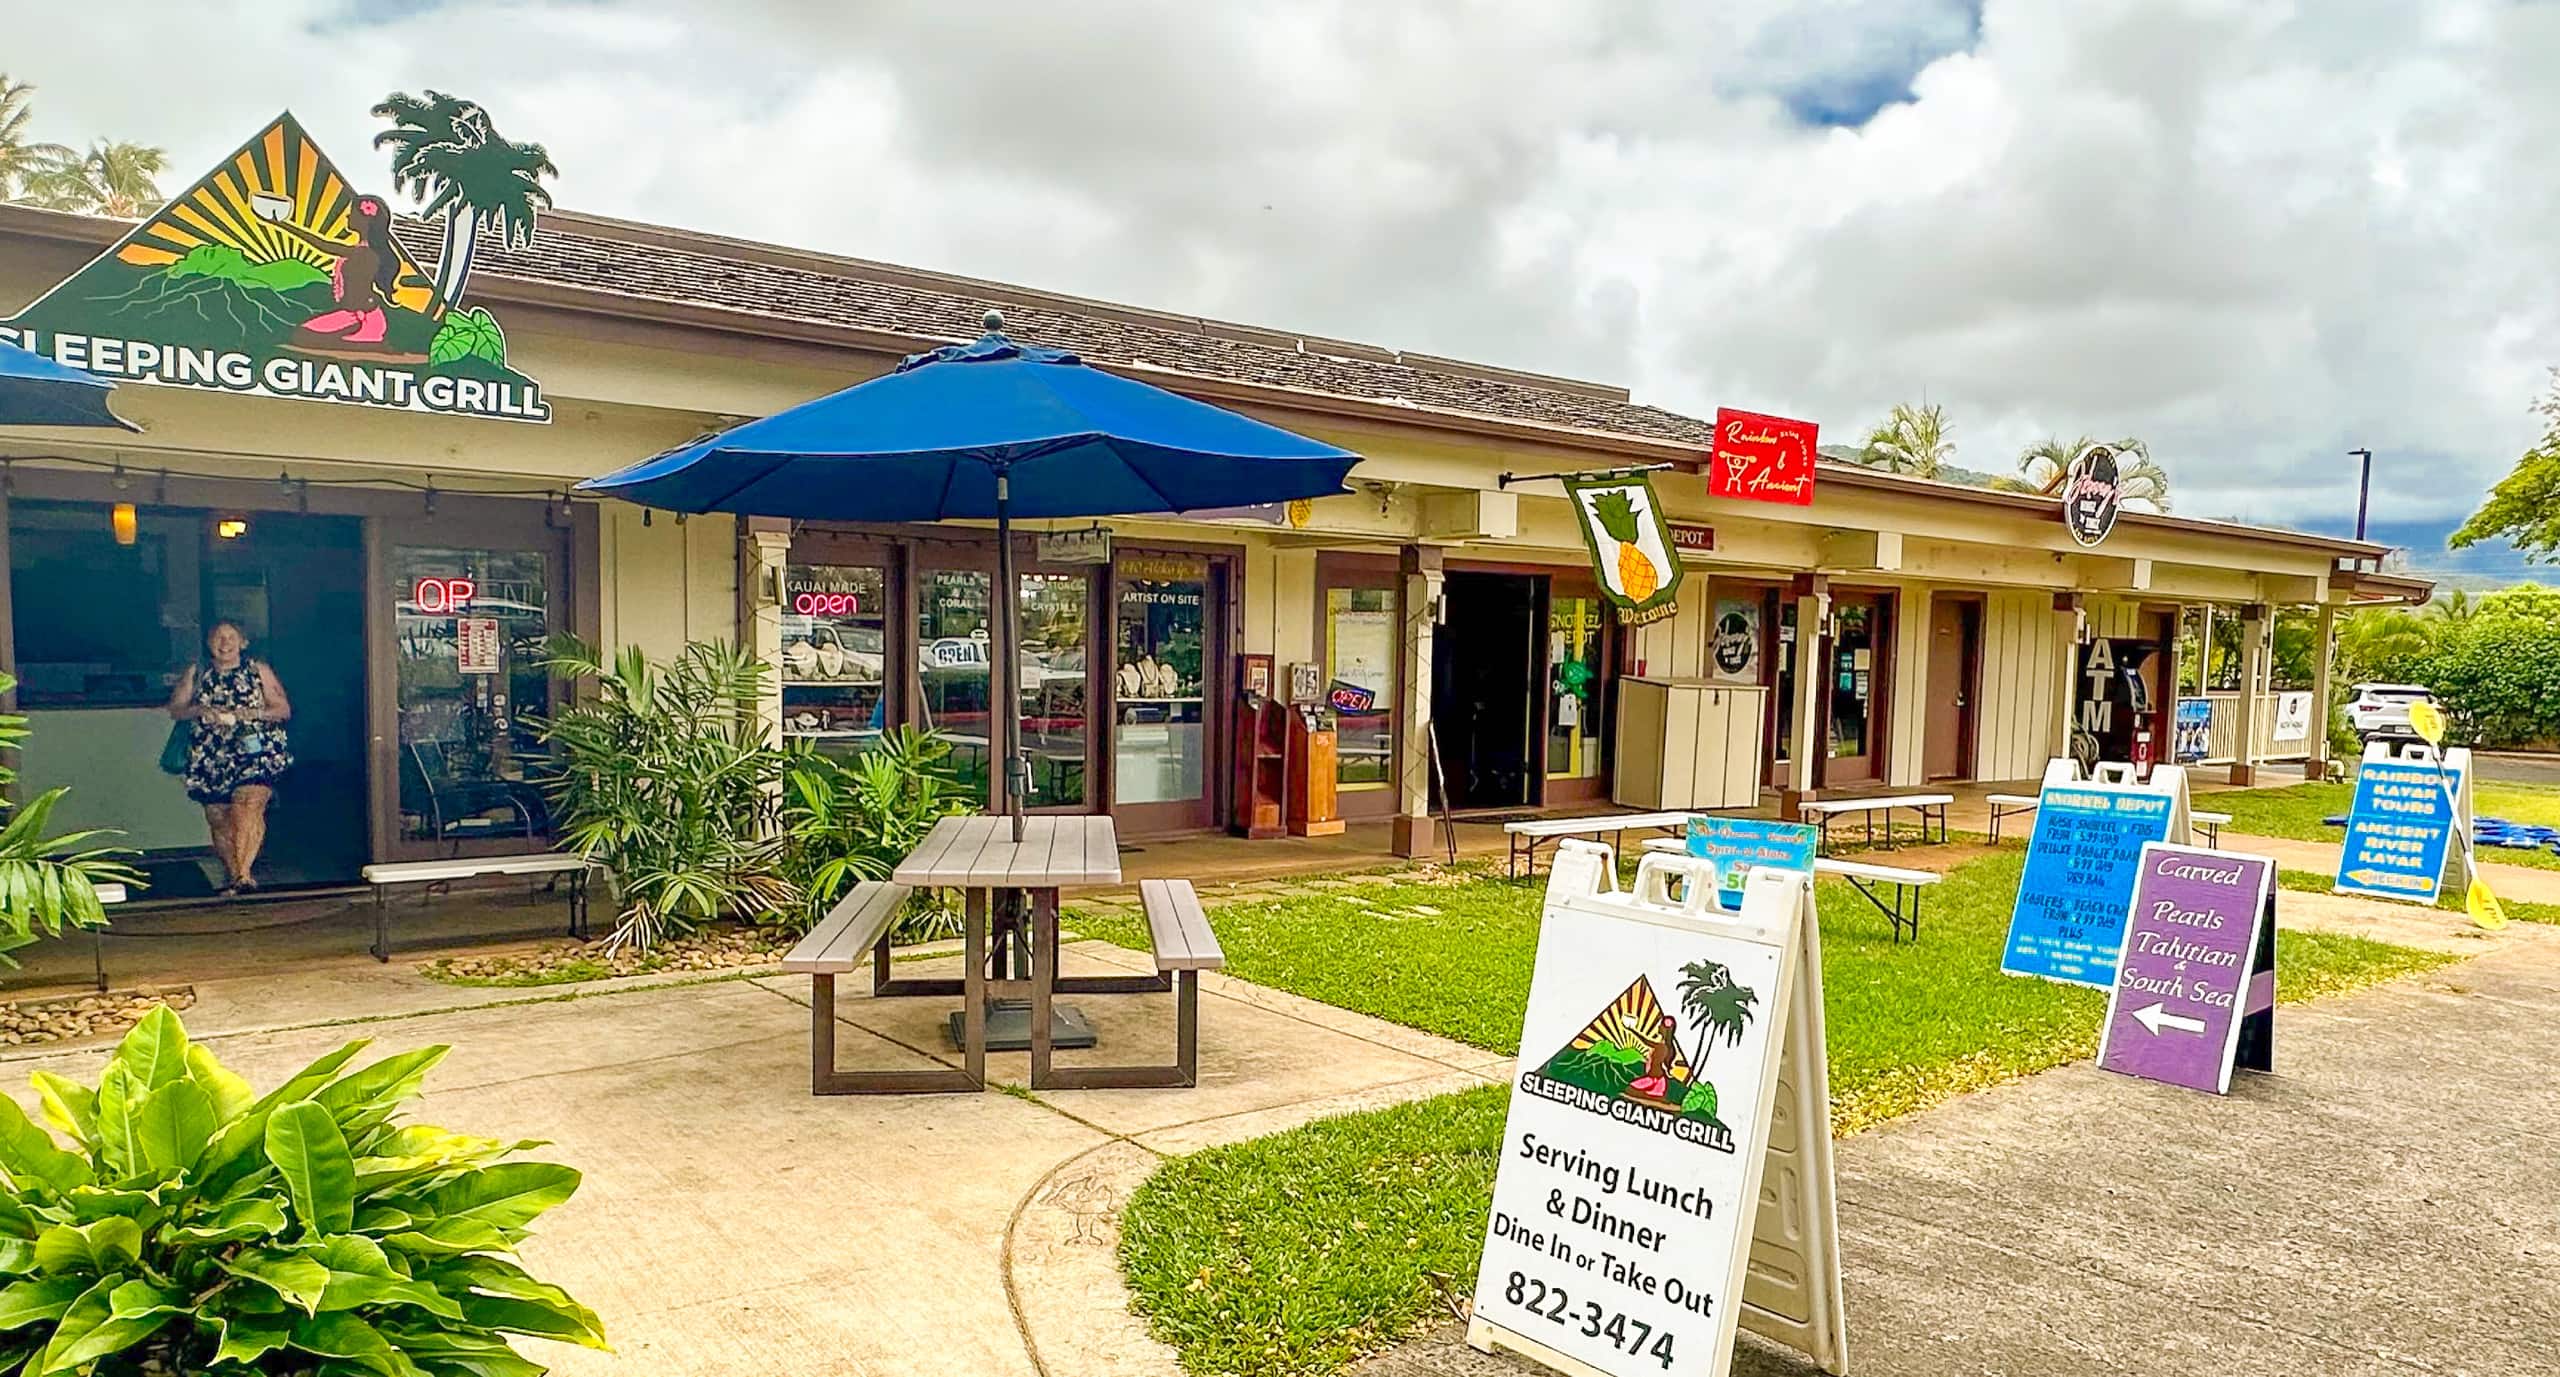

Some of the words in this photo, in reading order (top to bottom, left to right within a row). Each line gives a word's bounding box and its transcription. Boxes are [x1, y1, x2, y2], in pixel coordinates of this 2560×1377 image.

[264, 358, 413, 402] GIANT
[422, 376, 546, 418] GRILL
[787, 581, 826, 593] KAUAI
[830, 581, 868, 594] MADE
[1122, 592, 1159, 603] ARTIST
[1160, 594, 1175, 604] ON
[1178, 595, 1200, 606] SITE
[796, 594, 857, 617] open
[1551, 614, 1602, 629] SNOKEL
[1332, 689, 1372, 711] OPEN
[2373, 798, 2435, 814] TOURS
[2355, 822, 2440, 839] ANCIENT
[2365, 836, 2424, 852] RIVER
[2156, 857, 2243, 885] Carved
[2153, 900, 2224, 929] Pearls
[2136, 931, 2237, 967] Tahitian
[2174, 960, 2187, 971] &
[2120, 967, 2183, 998] South
[2189, 981, 2235, 1008] Sea
[1522, 1073, 1609, 1114] SLEEPING
[1611, 1100, 1674, 1133] GIANT
[1675, 1118, 1735, 1153] GRILL
[1520, 1133, 1619, 1194] Serving
[1627, 1167, 1713, 1220] Lunch
[1546, 1188, 1564, 1218] &
[1571, 1197, 1666, 1253] Dinner
[1494, 1212, 1545, 1251] Dine
[1550, 1233, 1571, 1262] In
[1576, 1253, 1595, 1271] or
[1601, 1252, 1657, 1295] Take
[1664, 1278, 1713, 1318] Out
[1505, 1271, 1675, 1370] 822-3474
